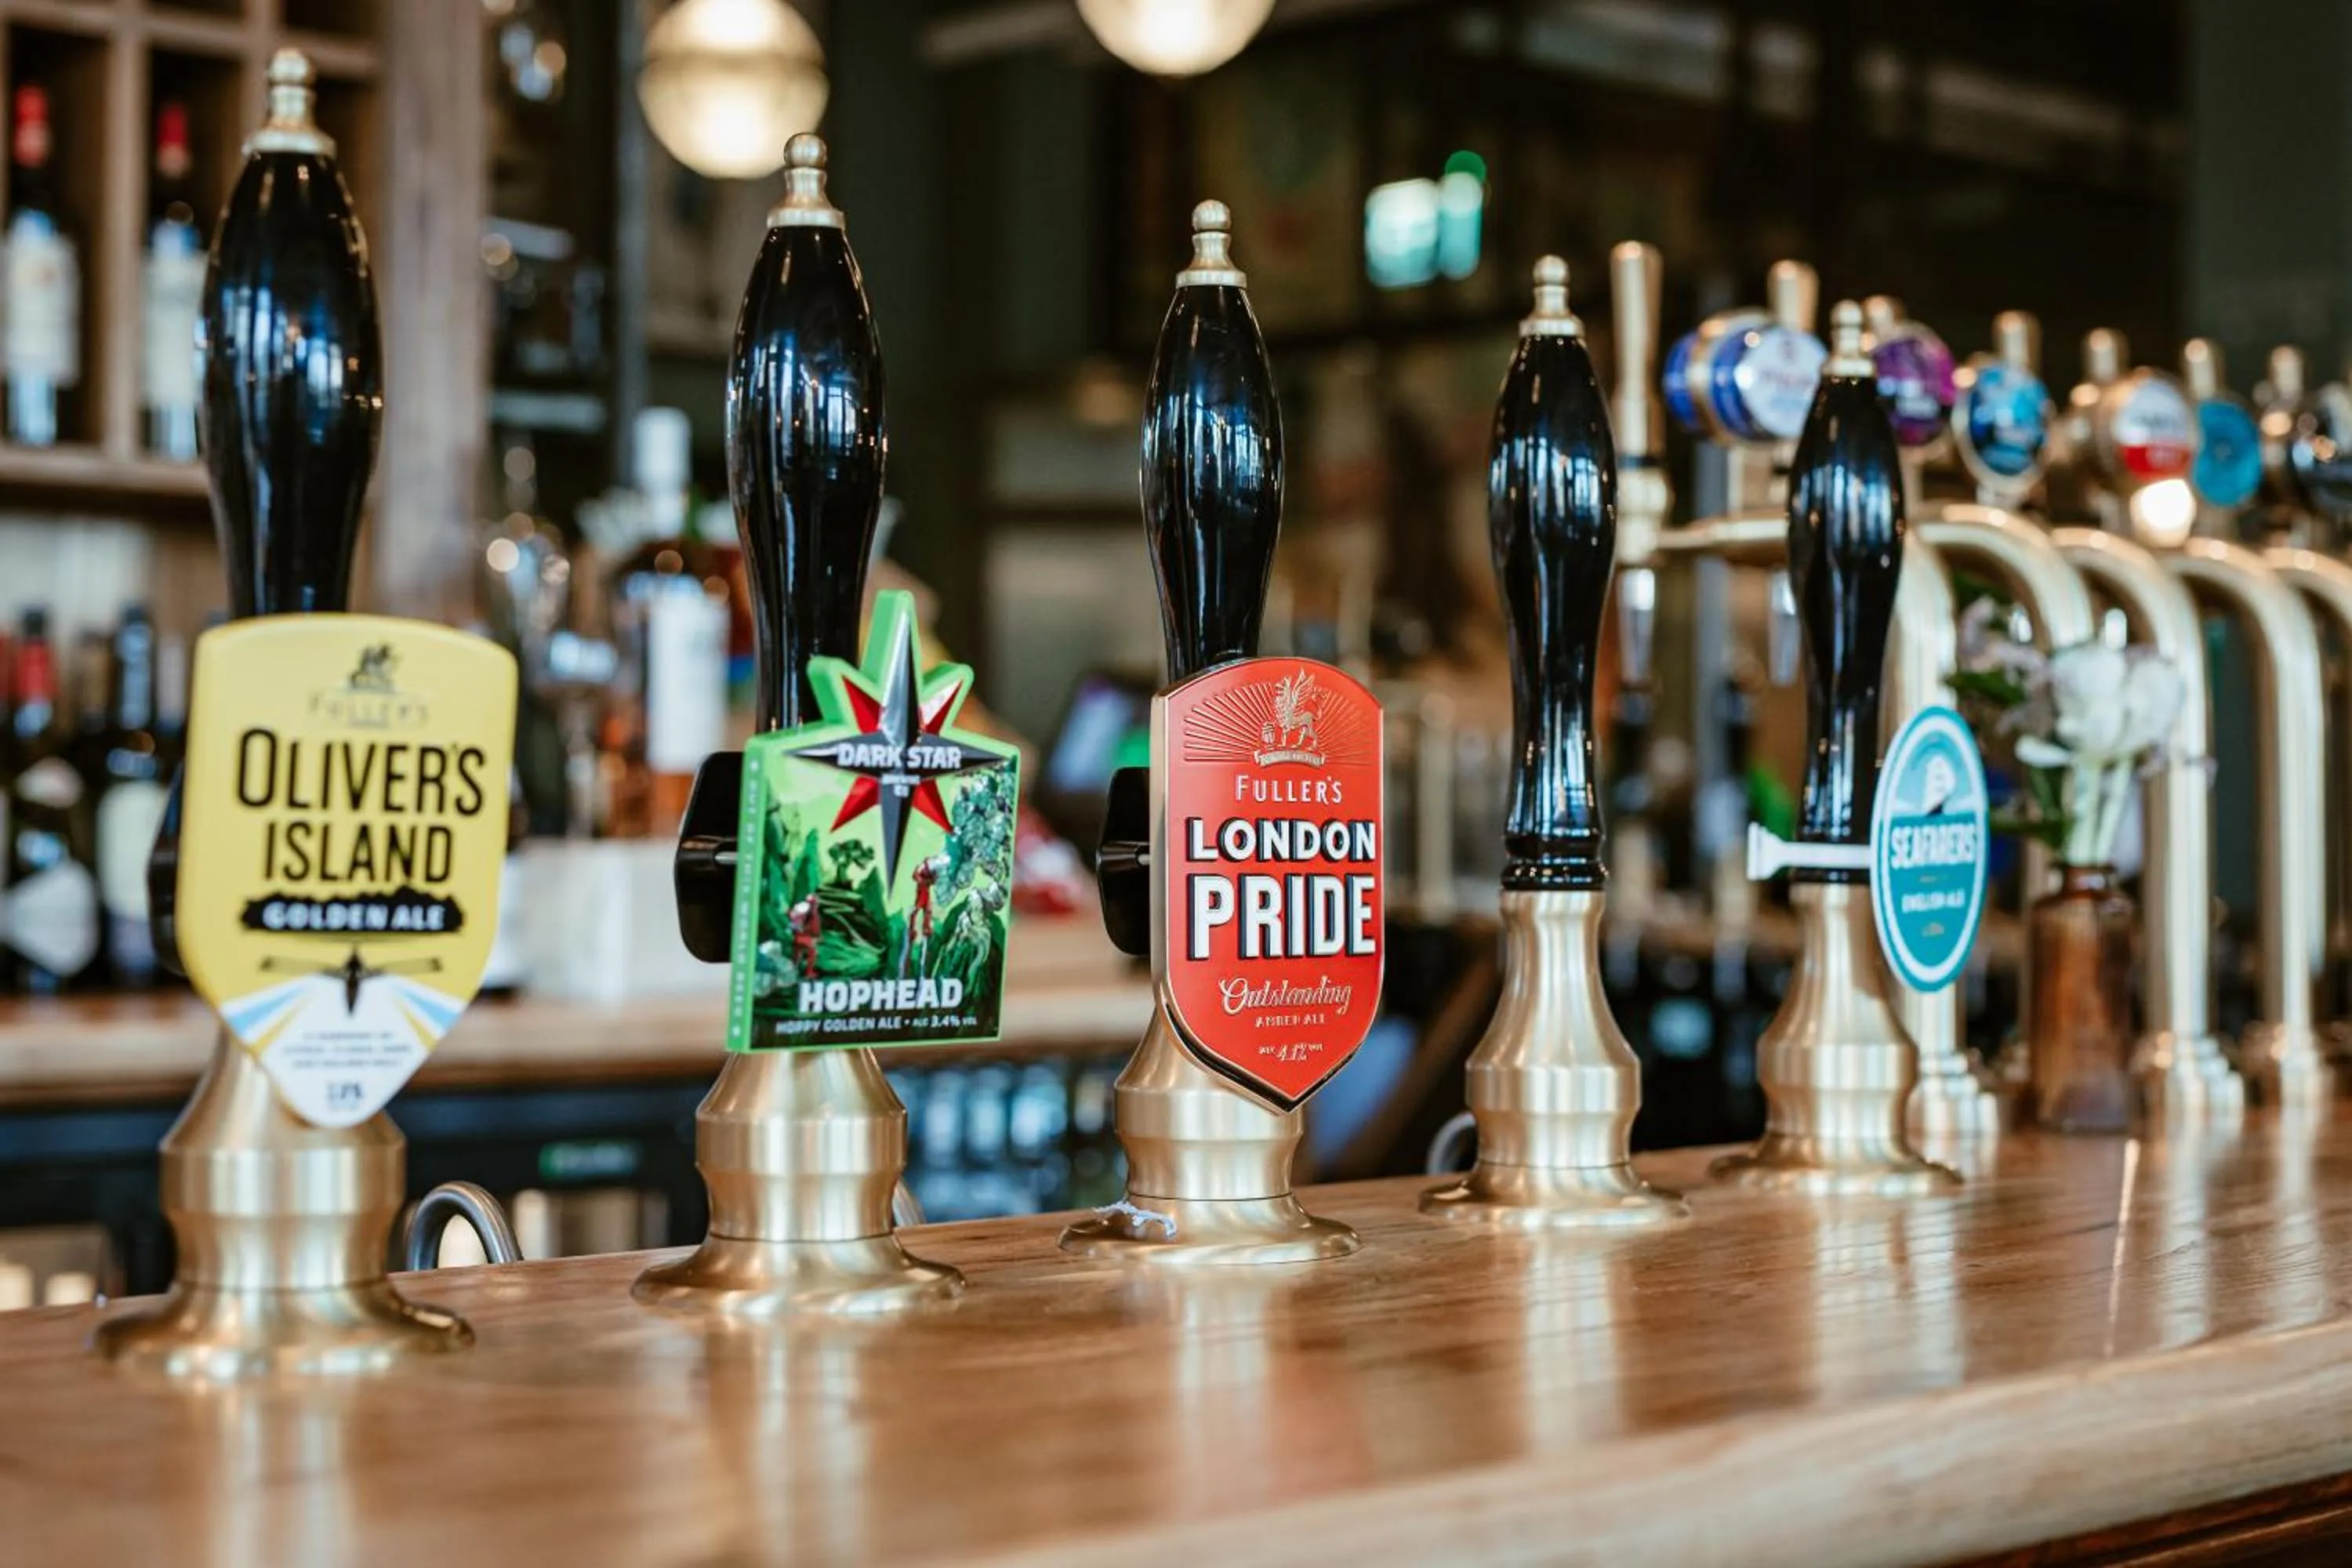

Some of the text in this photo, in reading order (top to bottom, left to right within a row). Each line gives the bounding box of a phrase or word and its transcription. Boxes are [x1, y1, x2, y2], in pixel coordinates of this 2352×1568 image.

[238, 728, 485, 816] OLIVER'S
[837, 742, 961, 768] DARK STAR
[1236, 774, 1342, 805] FULLER'S
[264, 821, 453, 883] ISLAND
[1185, 817, 1376, 862] LONDON
[262, 902, 445, 931] GOLDEN ALE
[1185, 873, 1376, 960] PRIDE
[799, 978, 964, 1014] HOPHEAD
[1219, 975, 1352, 1015] Outstanding
[775, 1021, 821, 1034] HOPPY
[823, 1018, 876, 1033] GOLDEN
[877, 1016, 902, 1029] ALE
[931, 1015, 960, 1028] 3.4%
